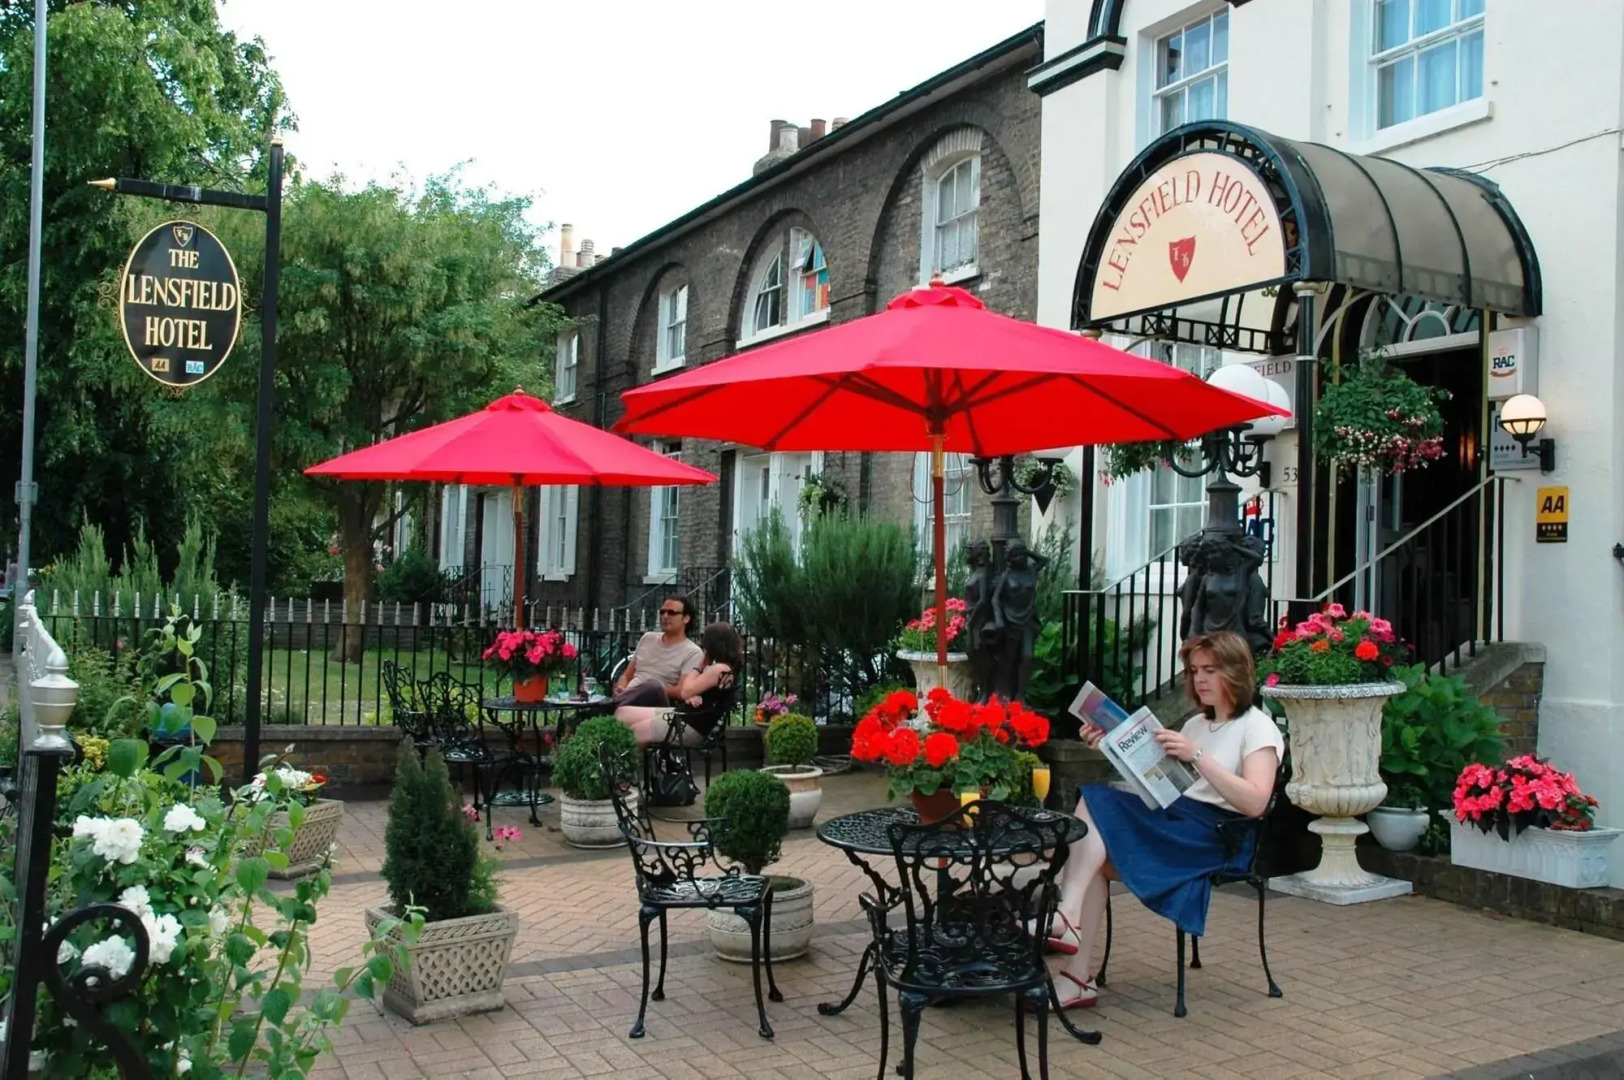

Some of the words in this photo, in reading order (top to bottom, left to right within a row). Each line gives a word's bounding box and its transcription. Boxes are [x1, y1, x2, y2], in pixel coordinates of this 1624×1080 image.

[1102, 170, 1200, 292] LENSFIELD
[1208, 170, 1270, 256] HOTEL
[168, 248, 200, 269] THE
[127, 274, 236, 311] LENSFIELD
[145, 316, 212, 350] HOTEL
[155, 360, 166, 370] AA
[1492, 355, 1516, 369] RAC
[1541, 495, 1565, 514] AA
[1117, 725, 1148, 753] Review
